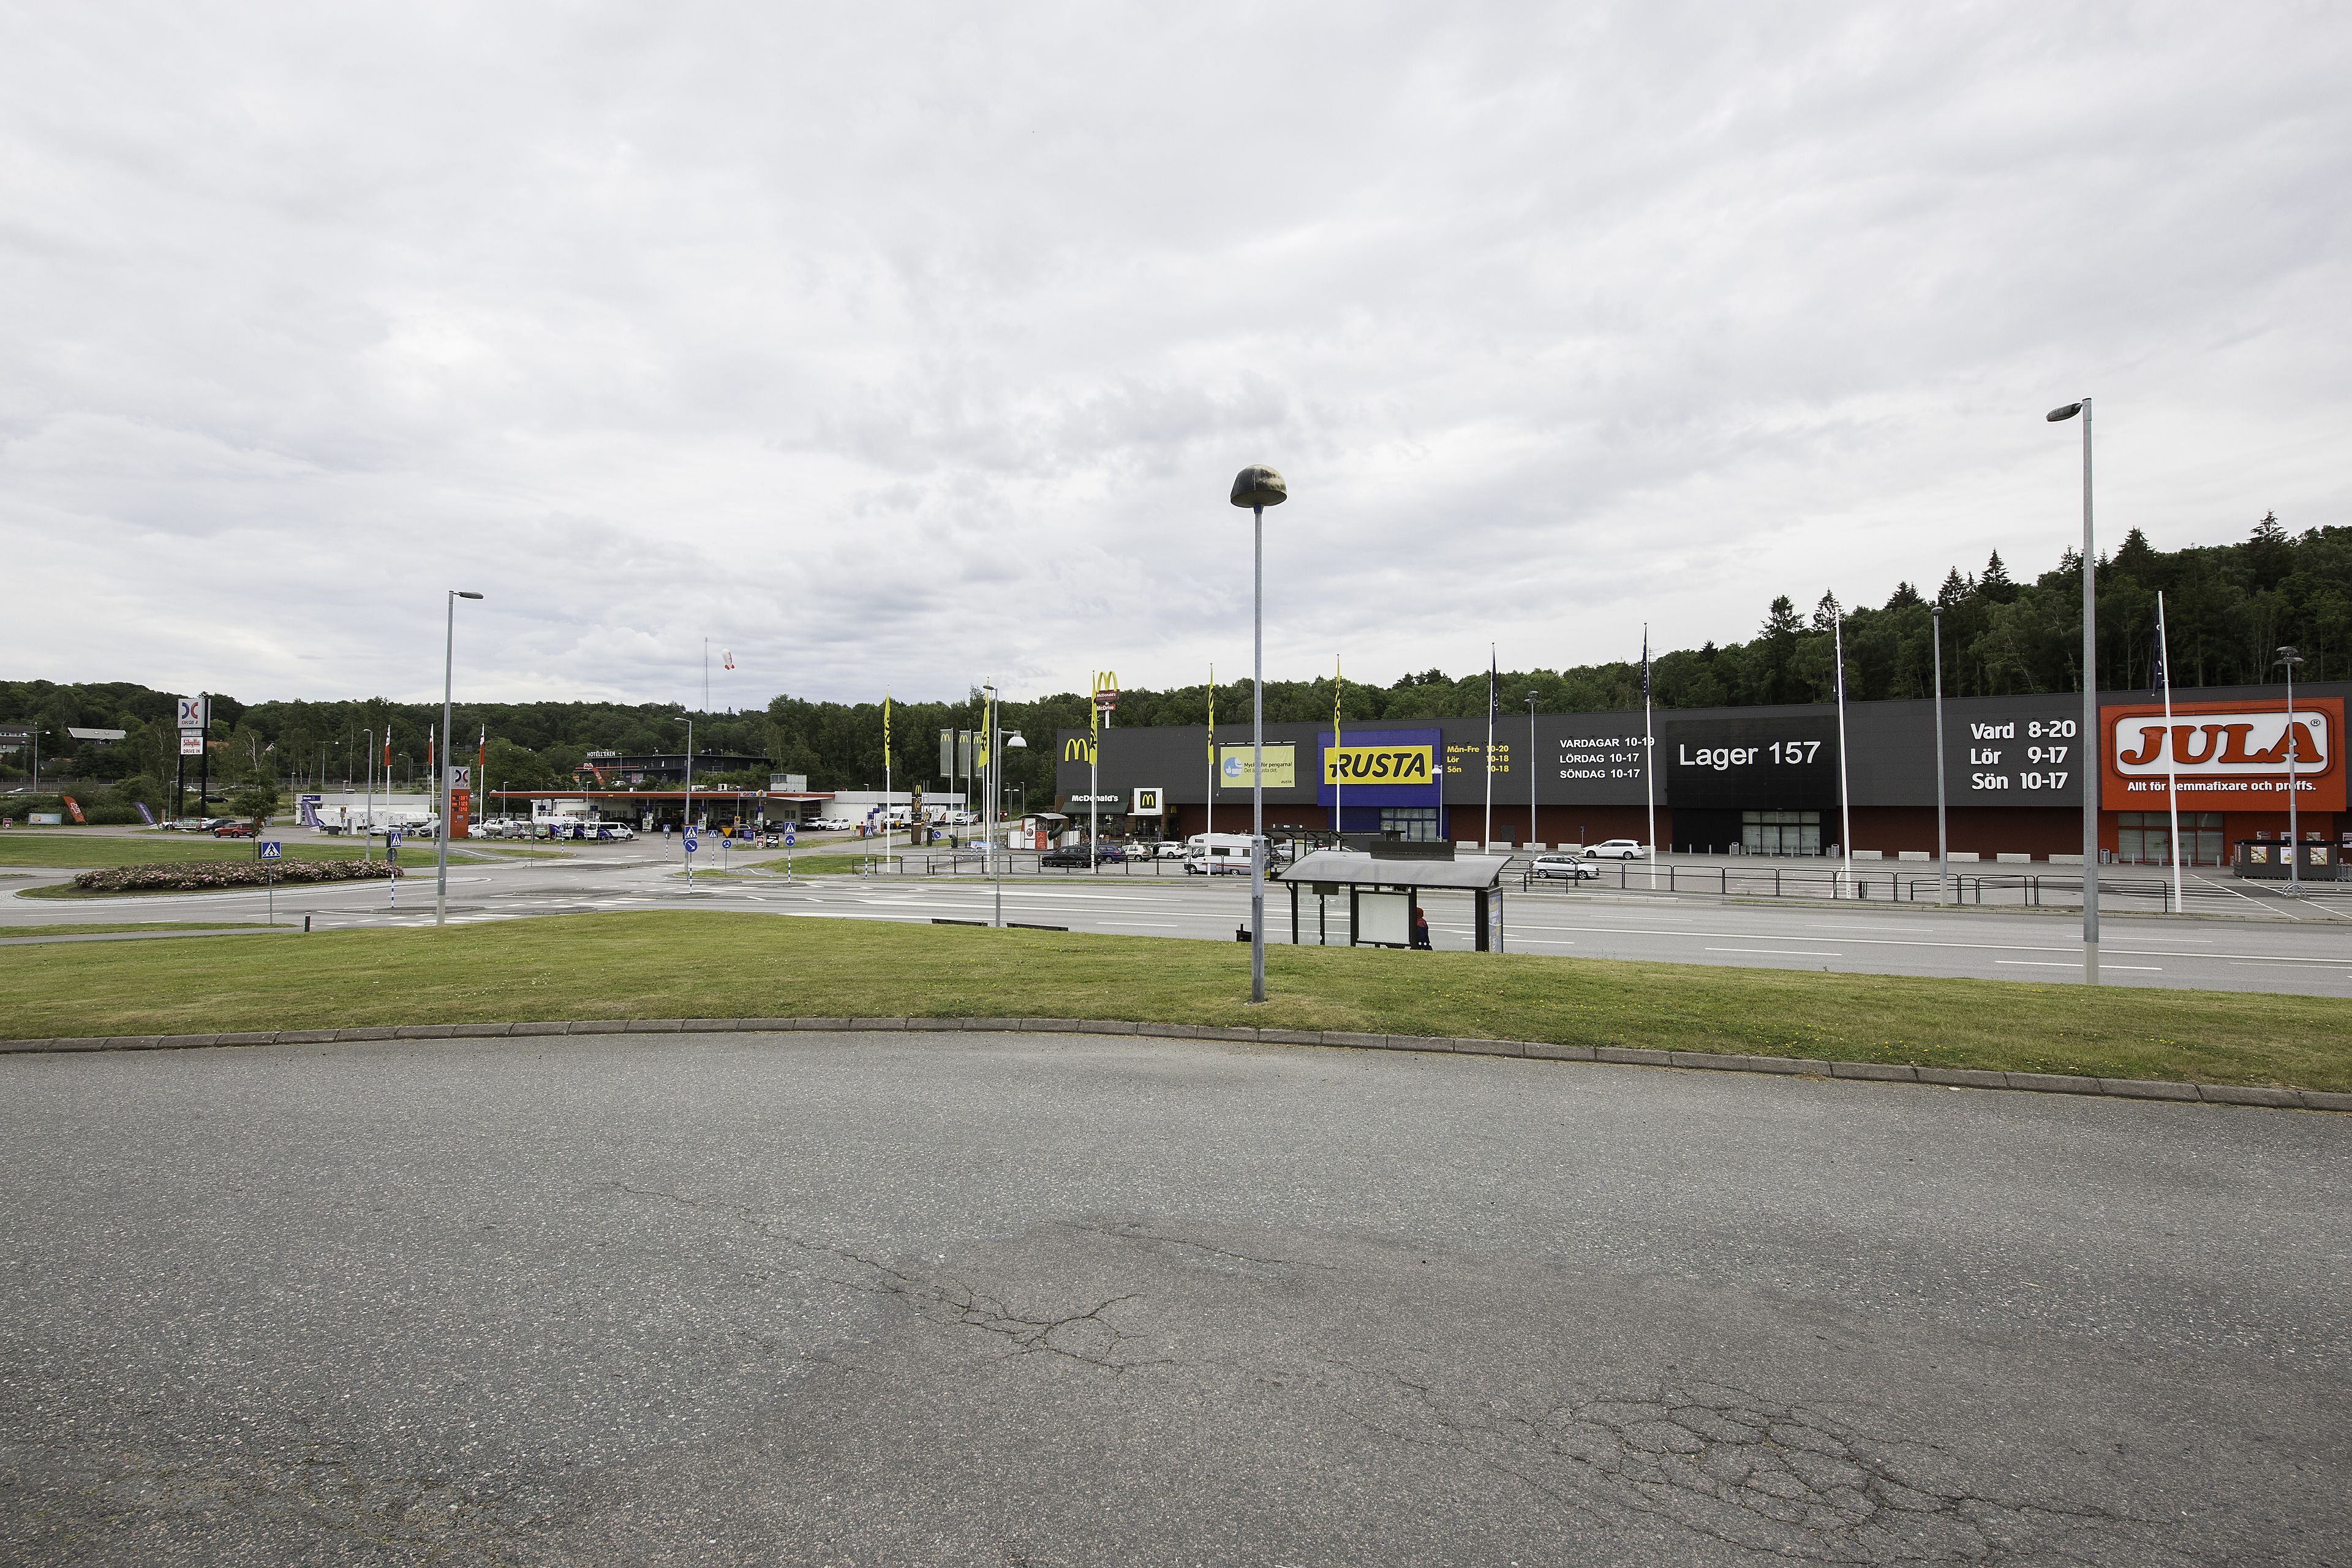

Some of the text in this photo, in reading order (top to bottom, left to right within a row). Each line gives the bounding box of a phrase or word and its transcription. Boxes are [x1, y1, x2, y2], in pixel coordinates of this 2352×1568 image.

[1970, 720, 2076, 739] Vard 8-20
[1560, 737, 1655, 748] VARDAGAR 10-19
[2120, 722, 2324, 764] JULA
[1559, 753, 1639, 763] LÖRDAG 10-17
[1679, 741, 1821, 771] Lager 157
[1970, 746, 2068, 764] Lör 9-17
[1329, 753, 1425, 778] RUSTA
[1560, 769, 1640, 778] SÖNDAG 10-17
[1972, 772, 2068, 790] Sön 10-17
[2127, 782, 2147, 791] Allt
[2149, 782, 2166, 791] för
[2175, 781, 2247, 791] emmafixare
[2251, 781, 2272, 791] och
